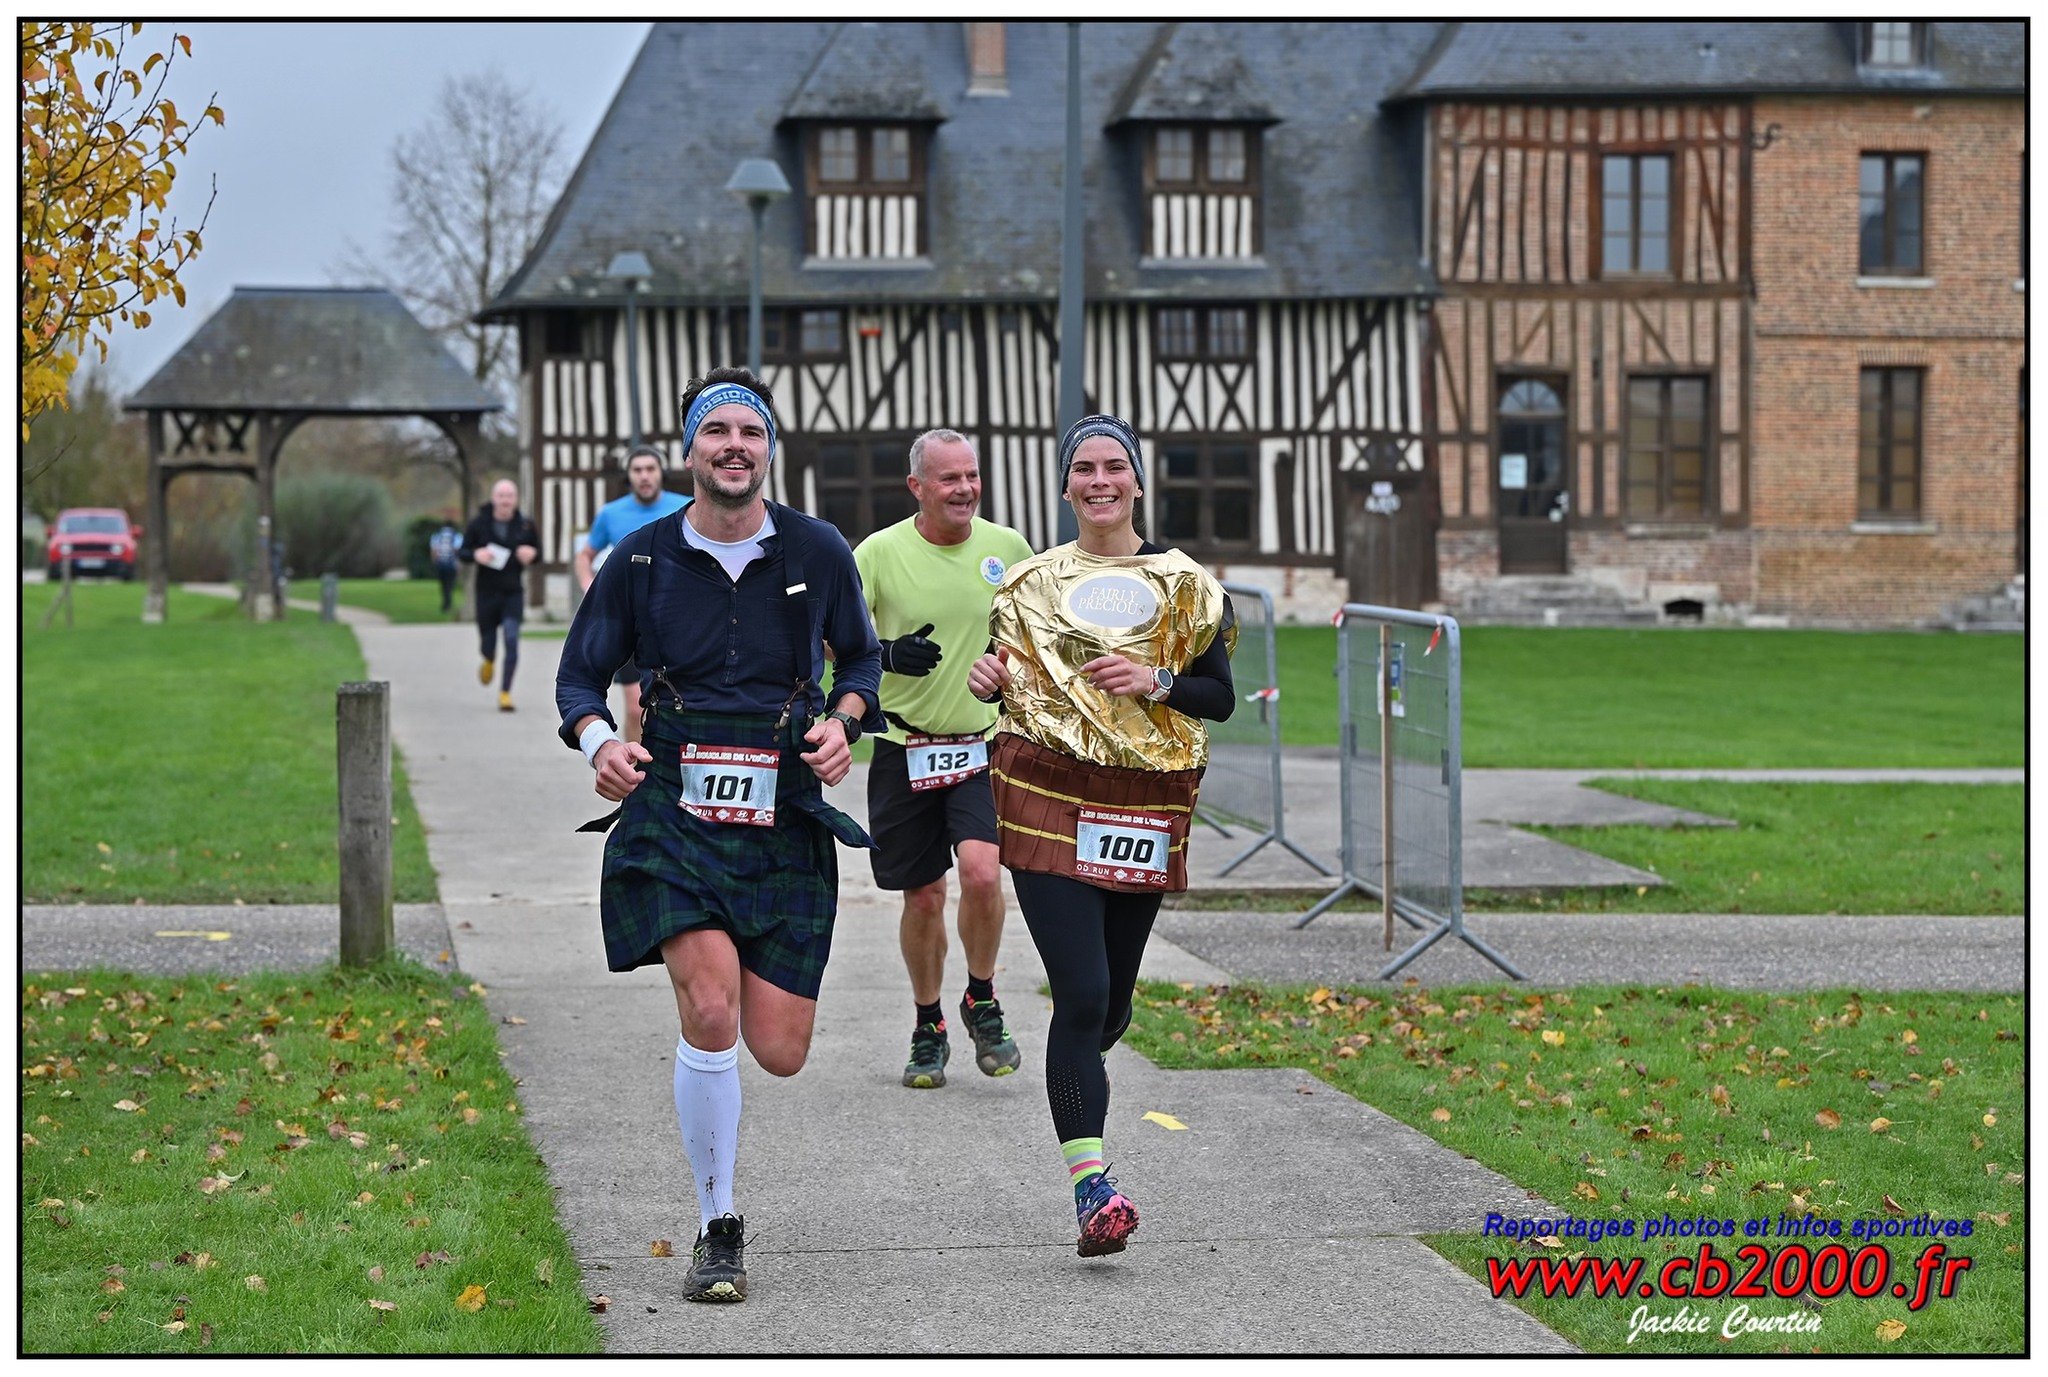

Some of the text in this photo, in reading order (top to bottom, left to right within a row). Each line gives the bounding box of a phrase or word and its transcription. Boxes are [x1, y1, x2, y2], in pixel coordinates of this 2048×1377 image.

[1090, 587, 1138, 603] FAIRLY
[1078, 597, 1146, 617] PRECIOUS
[927, 751, 969, 772] 132
[703, 774, 753, 802] 101
[1080, 809, 1096, 819] LES
[1096, 811, 1133, 823] BOUCLES
[1133, 816, 1145, 824] DE
[1099, 834, 1155, 864] 100
[1076, 863, 1089, 872] OD
[1092, 866, 1110, 876] RUN
